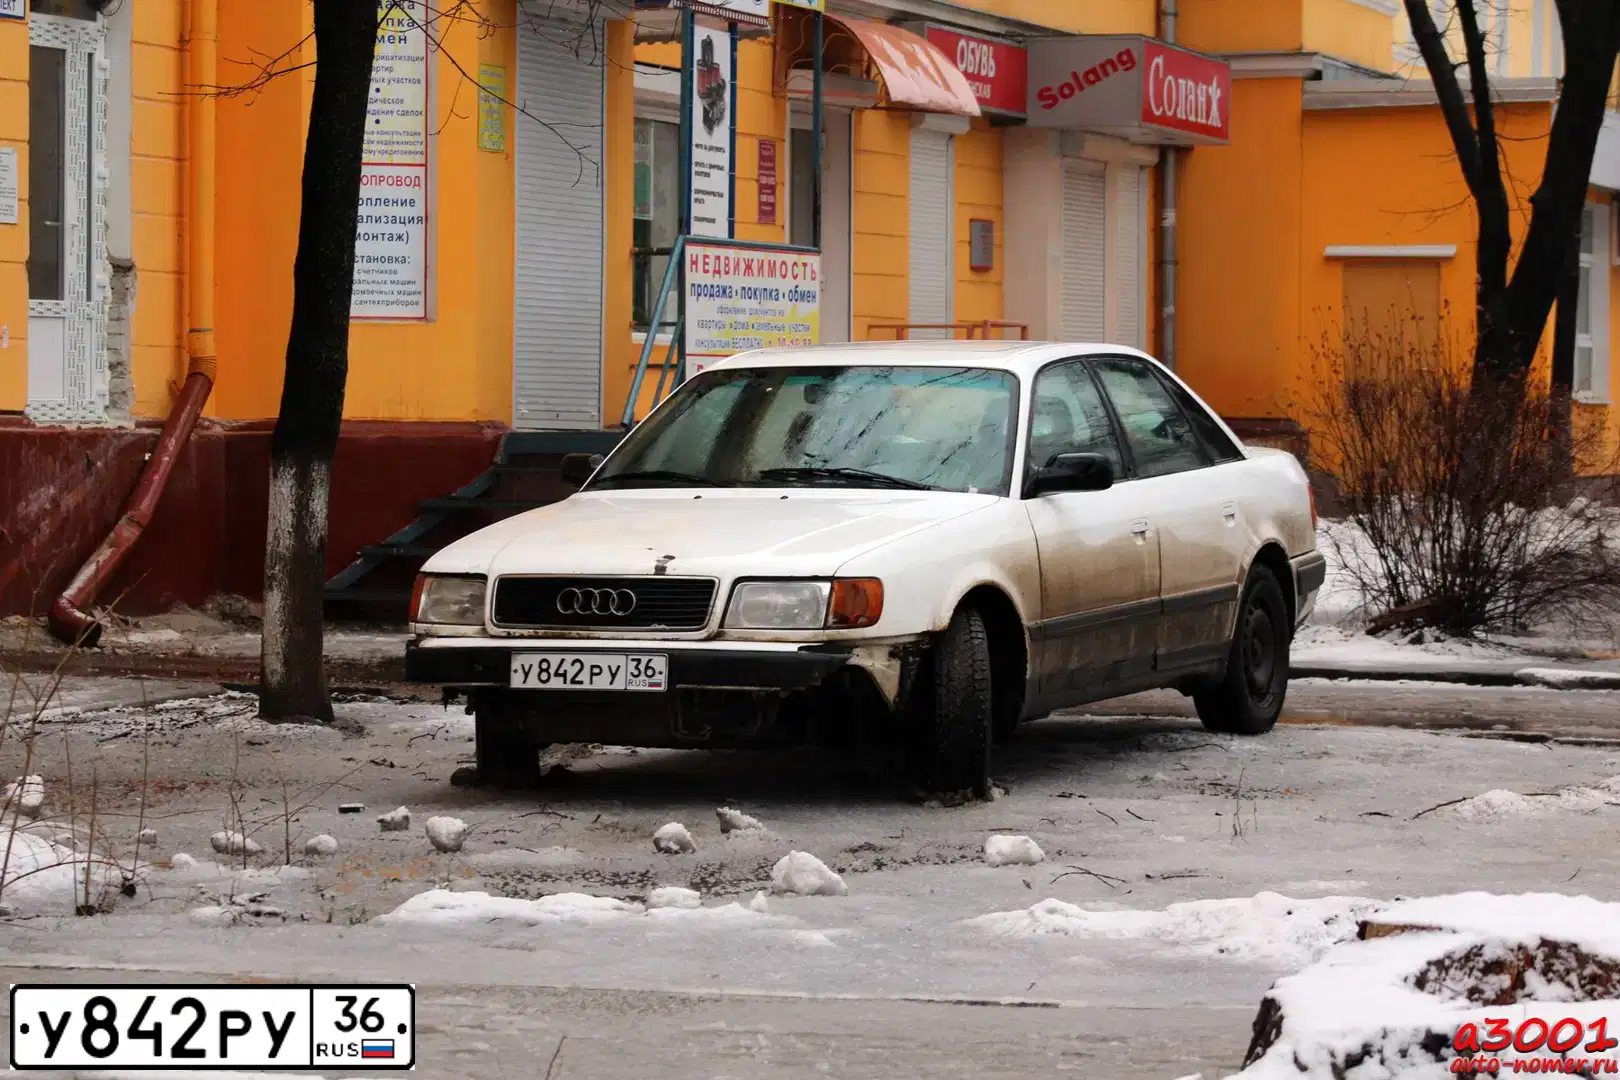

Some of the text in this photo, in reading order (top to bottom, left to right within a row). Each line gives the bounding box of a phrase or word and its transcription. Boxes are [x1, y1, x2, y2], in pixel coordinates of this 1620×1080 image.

[957, 38, 996, 78] ОБУВЬ
[387, 77, 422, 86] участков
[1036, 48, 1137, 110] Solang
[396, 109, 424, 117] сделок
[360, 174, 422, 188] ОПРОВОД
[358, 197, 416, 207] опление
[357, 214, 424, 226] ализация
[689, 253, 817, 281] НЕДВИЖИМОСТЬ
[396, 289, 422, 297] машин
[690, 282, 817, 305] продажа покупка обмен
[630, 658, 656, 678] 36
[628, 679, 647, 688] RUS
